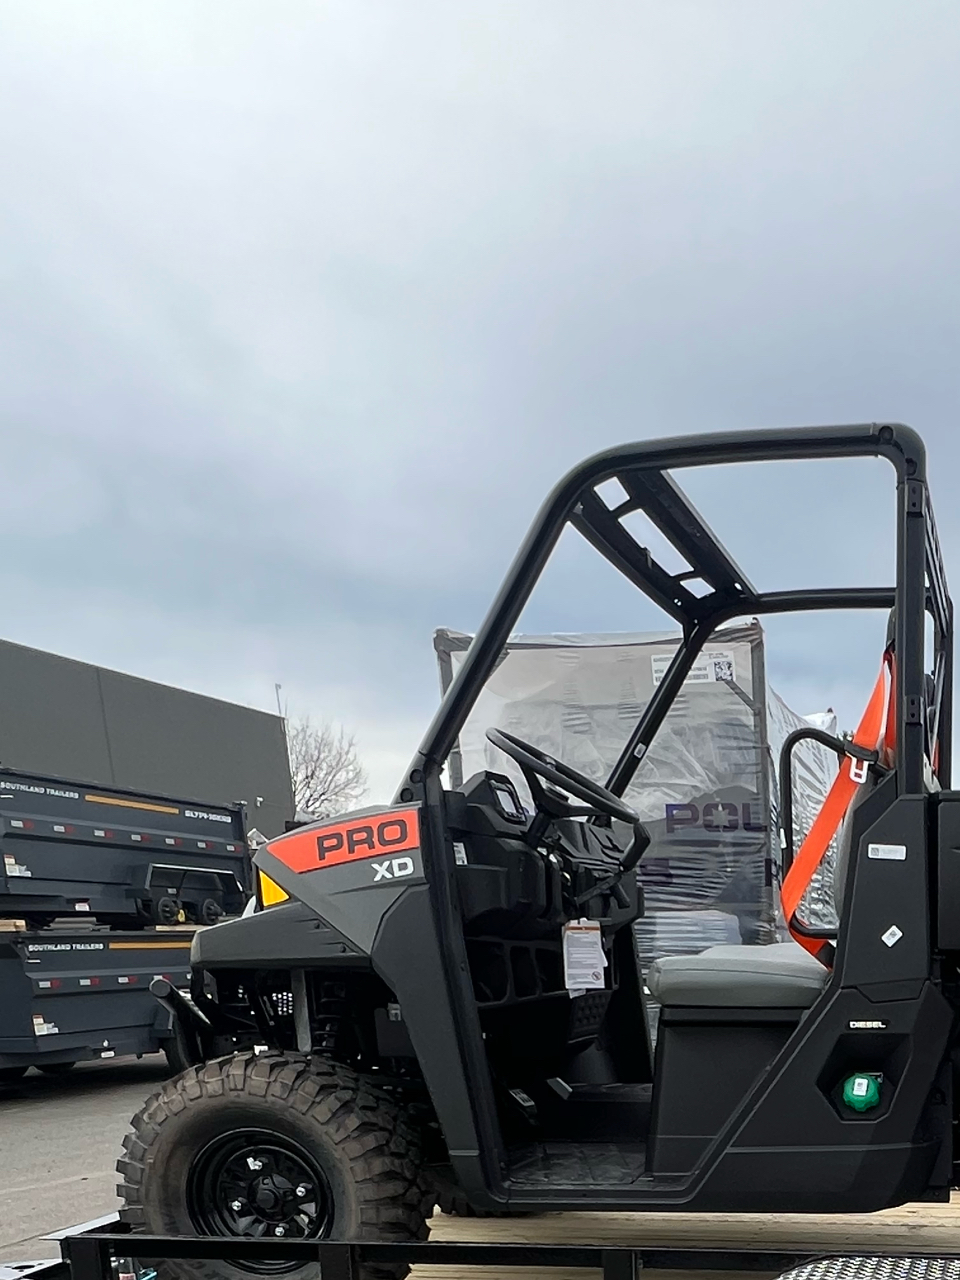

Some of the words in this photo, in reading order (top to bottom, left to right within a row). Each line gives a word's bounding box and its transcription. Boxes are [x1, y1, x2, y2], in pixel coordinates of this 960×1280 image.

[0, 782, 45, 794] SOUTHLAND
[46, 788, 79, 799] TRAILERS
[317, 819, 408, 861] PRO
[371, 857, 414, 882] XD
[28, 944, 71, 952] SOUTHLAND
[850, 1021, 887, 1029] DIESEL
